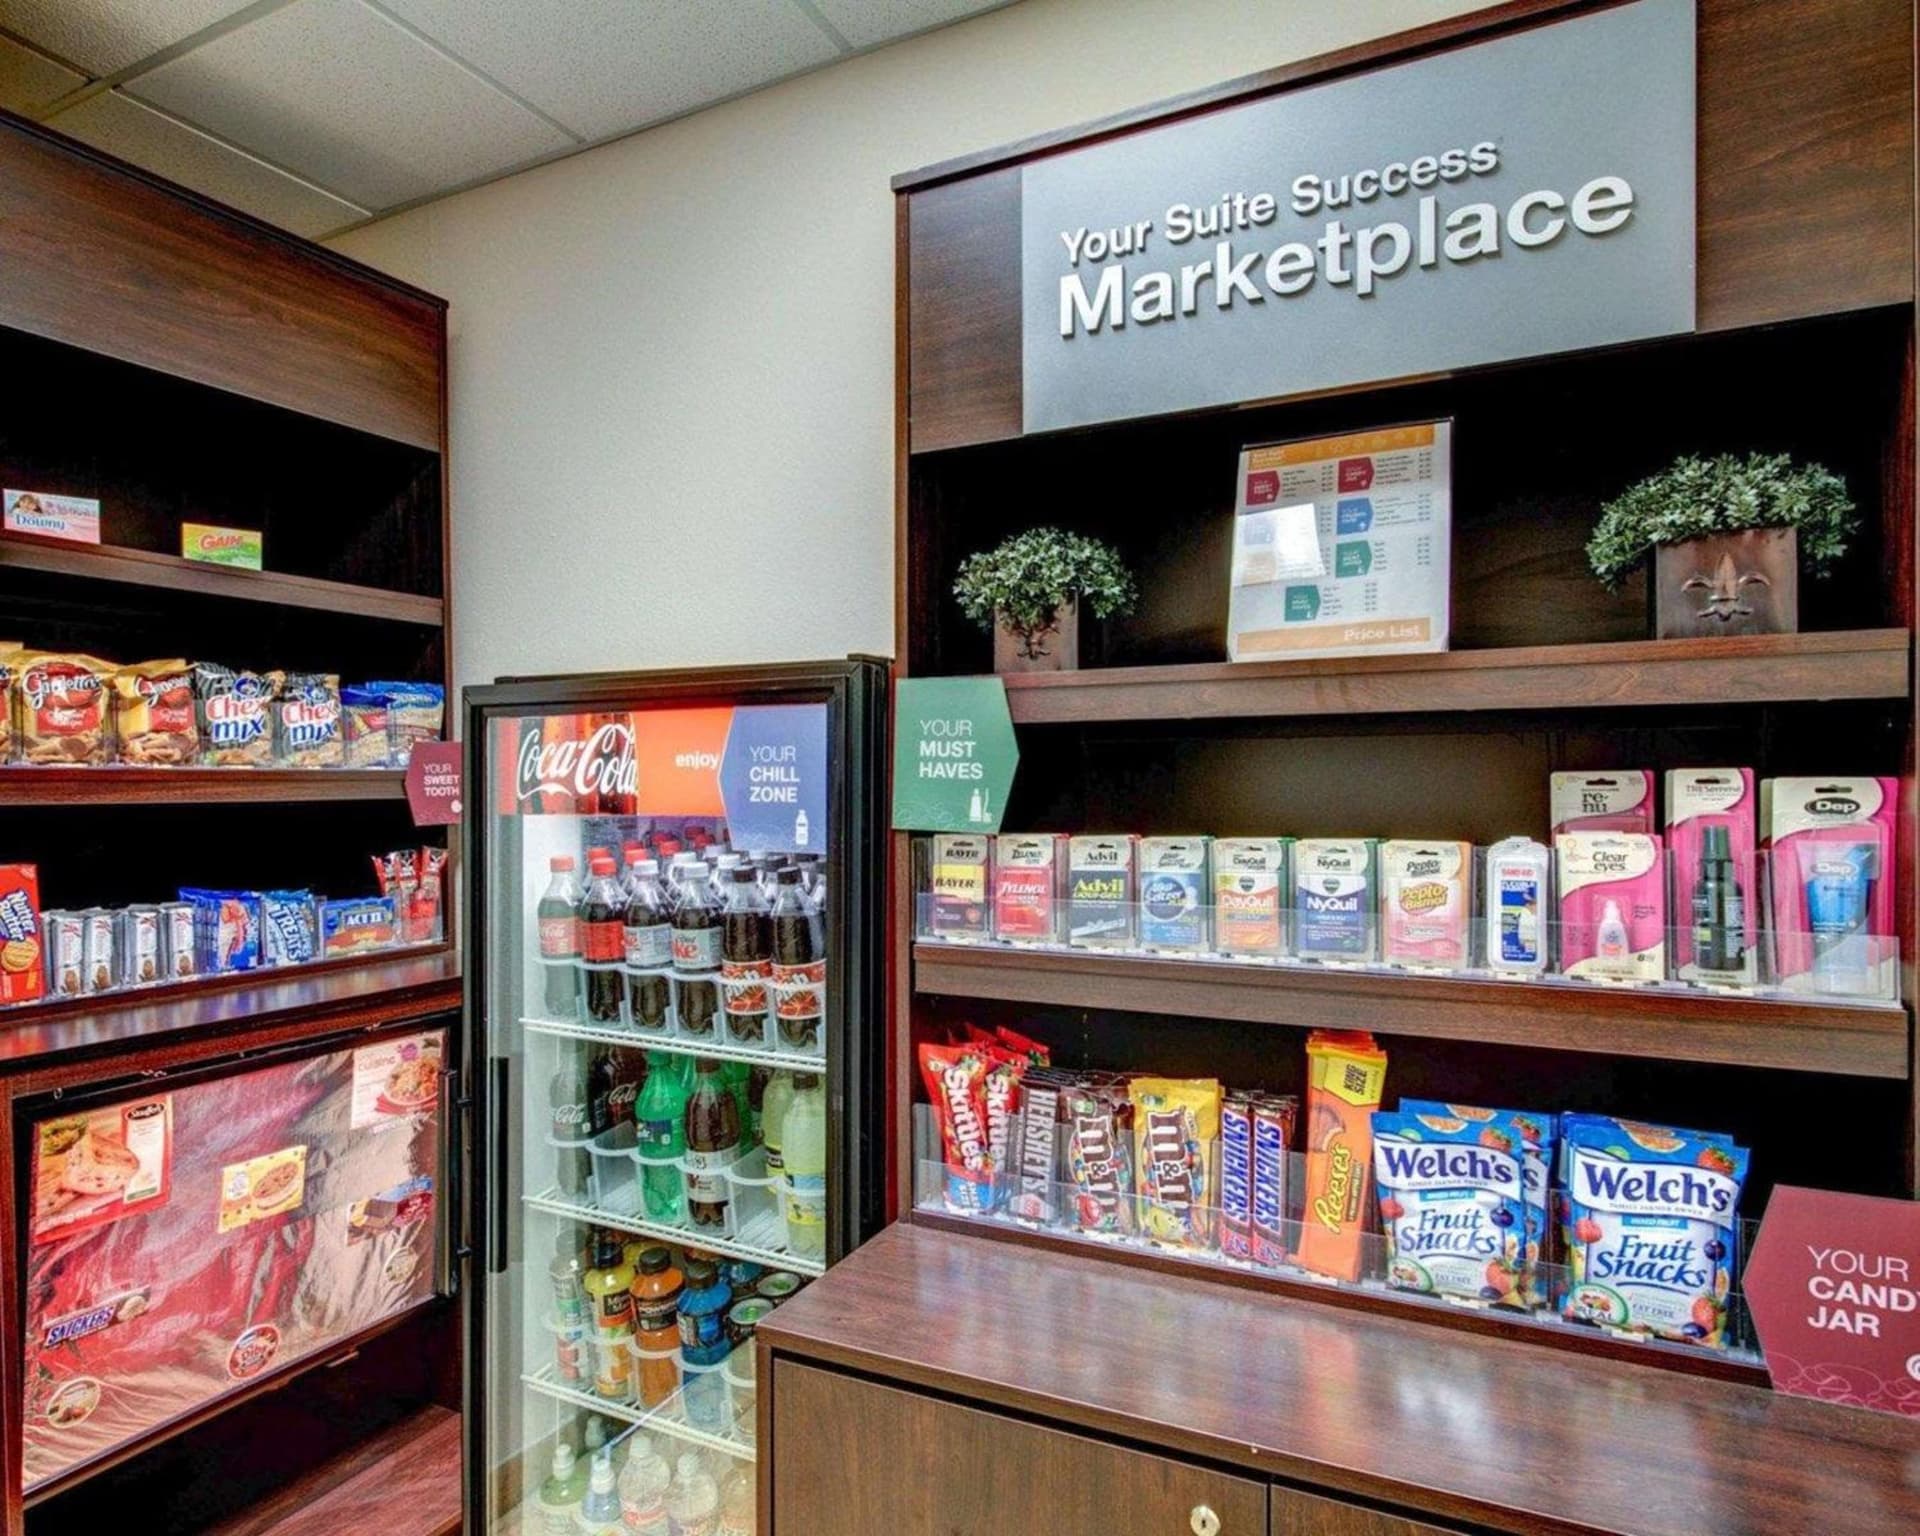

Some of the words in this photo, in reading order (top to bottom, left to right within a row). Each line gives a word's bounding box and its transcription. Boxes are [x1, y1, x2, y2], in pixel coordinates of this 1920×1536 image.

[1060, 217, 1152, 265] Your
[1165, 188, 1278, 245] Suite
[1291, 138, 1500, 214] Success
[1058, 173, 1636, 340] Marketplace
[15, 513, 65, 531] Downy
[1343, 627, 1385, 642] Price
[1389, 624, 1422, 639] List
[205, 694, 271, 721] Chex
[282, 700, 341, 726] Chex
[919, 719, 973, 737] YOUR
[749, 745, 796, 763] YOUR
[919, 740, 976, 758] MUST
[423, 763, 452, 774] YOUR
[517, 723, 638, 800] Coca-Cola
[675, 751, 720, 771] enjoy
[749, 766, 800, 783] CHILL
[919, 762, 984, 779] HAVES
[423, 774, 460, 786] SWEET
[423, 786, 460, 798] TOOTH
[749, 786, 799, 803] ZONE
[1814, 799, 1858, 815] Dep
[945, 849, 979, 859] BAYER
[1087, 851, 1119, 862] Advil
[1592, 851, 1629, 862] Clear
[1316, 858, 1351, 870] NyQuil
[1593, 863, 1627, 873] eyes
[935, 877, 976, 889] BAYER
[1073, 878, 1125, 894] Advil
[1223, 895, 1277, 910] DayQuil
[1306, 896, 1359, 913] NyQuil
[345, 911, 367, 926] ACT
[268, 903, 302, 960] TREATS
[943, 1068, 984, 1172] Skittles
[1223, 1112, 1249, 1224] SNICKERS
[1379, 1145, 1514, 1184] Welch's
[1255, 1119, 1281, 1234] SNICKERS
[1581, 1160, 1731, 1212] Welch's
[1418, 1207, 1484, 1232] Fruit
[1400, 1225, 1497, 1255] Snacks
[1616, 1233, 1697, 1262] Fruit
[1592, 1250, 1708, 1289] Snacks
[1807, 1244, 1910, 1283] YOUR
[1807, 1276, 1920, 1313] CAND
[47, 1305, 115, 1345] SNICKERS
[1807, 1306, 1881, 1339] JAR
